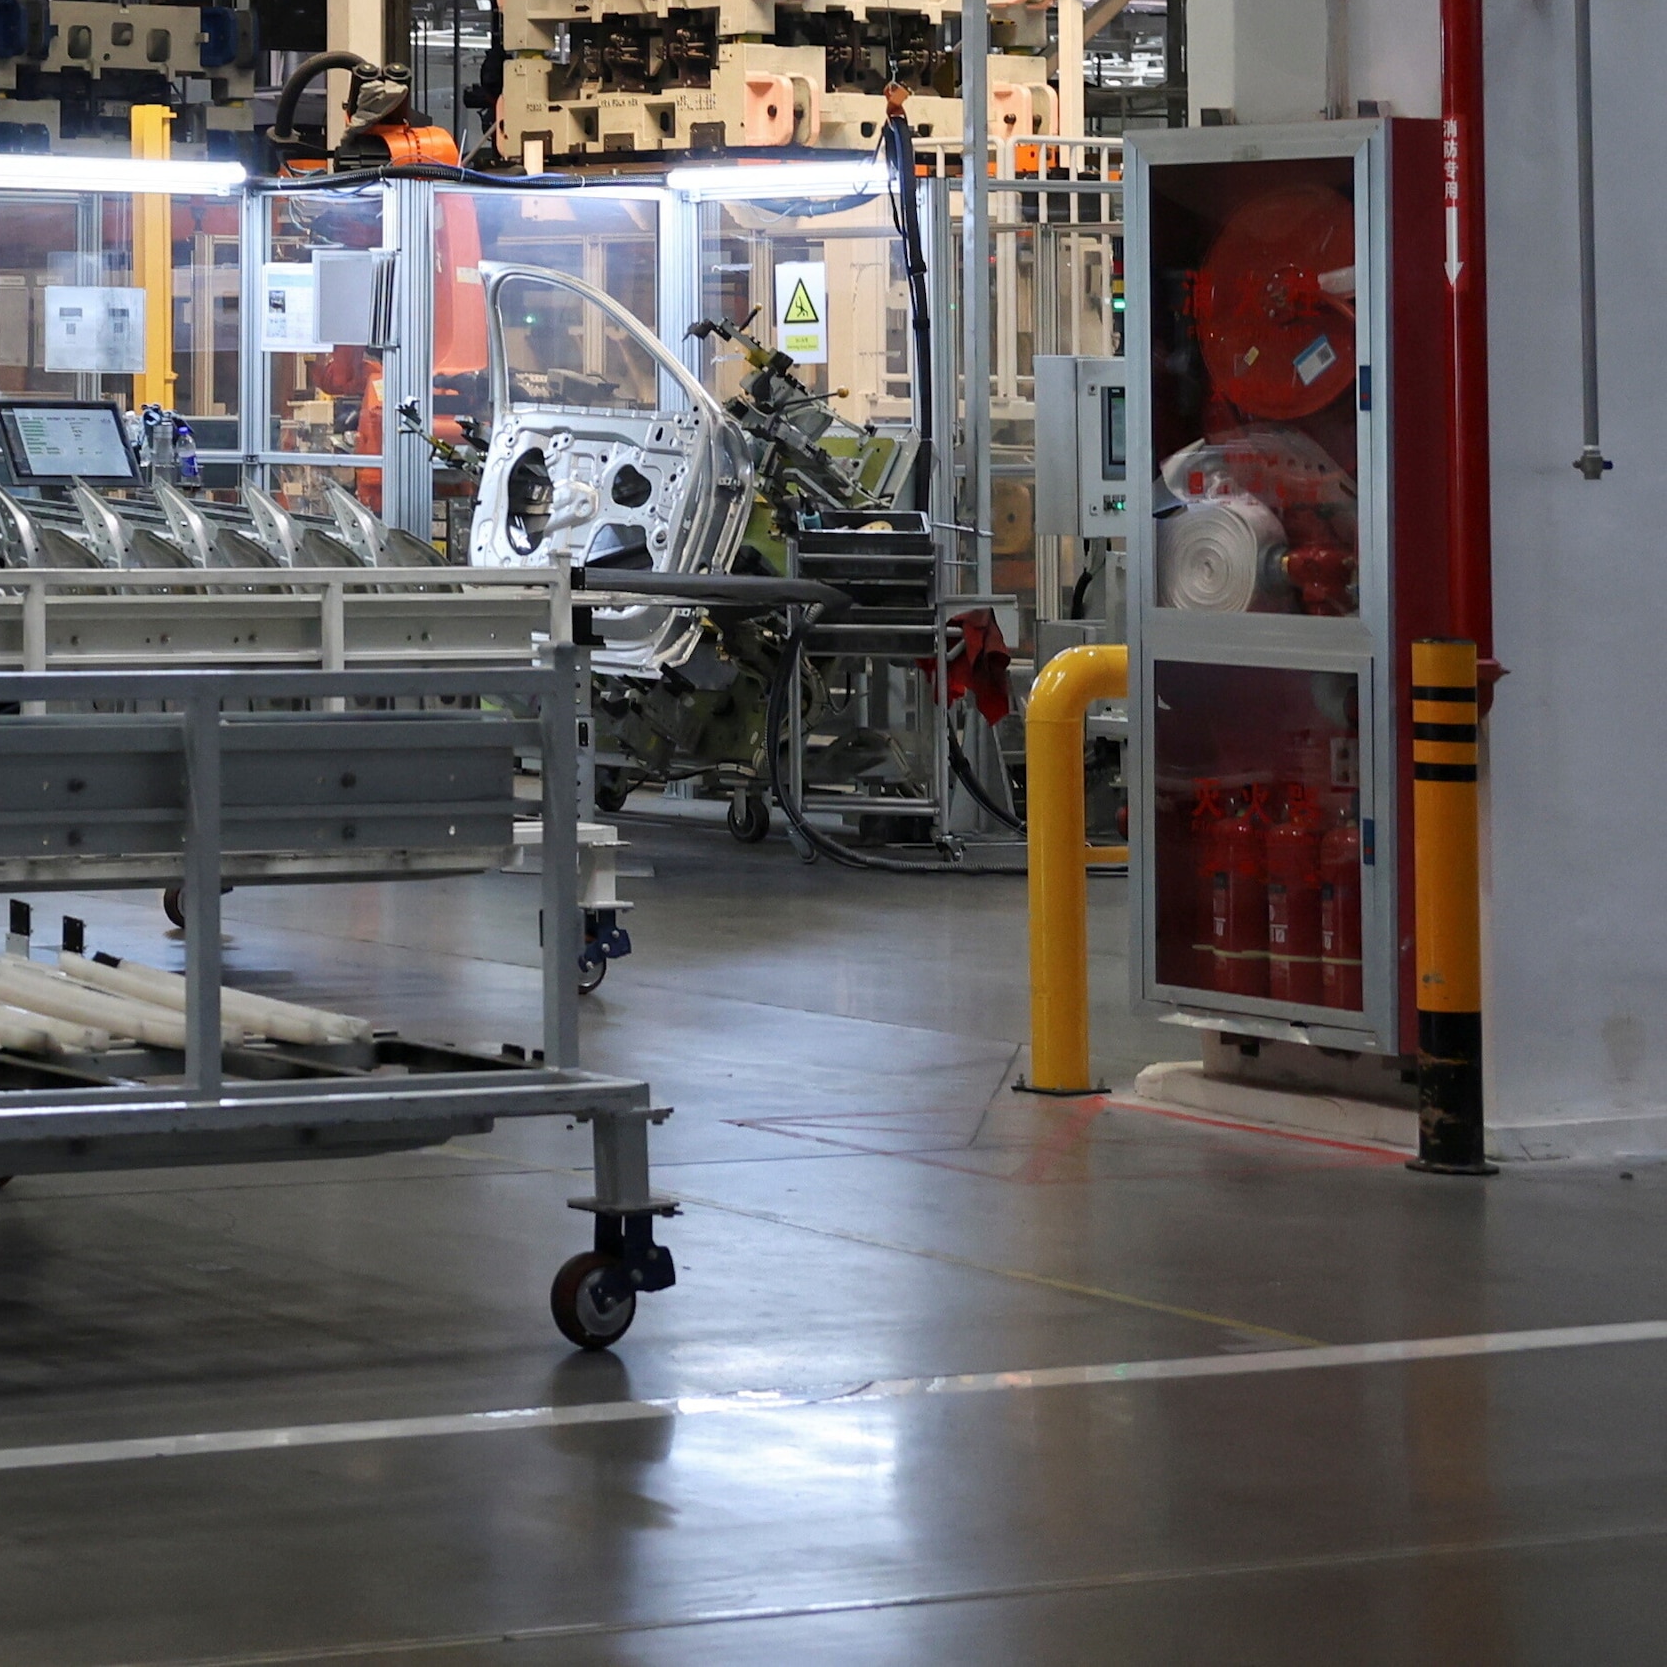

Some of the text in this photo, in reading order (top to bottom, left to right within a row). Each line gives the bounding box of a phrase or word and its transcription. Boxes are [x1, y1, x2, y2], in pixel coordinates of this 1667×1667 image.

[1443, 119, 1458, 200] 消防专用
[1191, 778, 1322, 829] 灭火器
